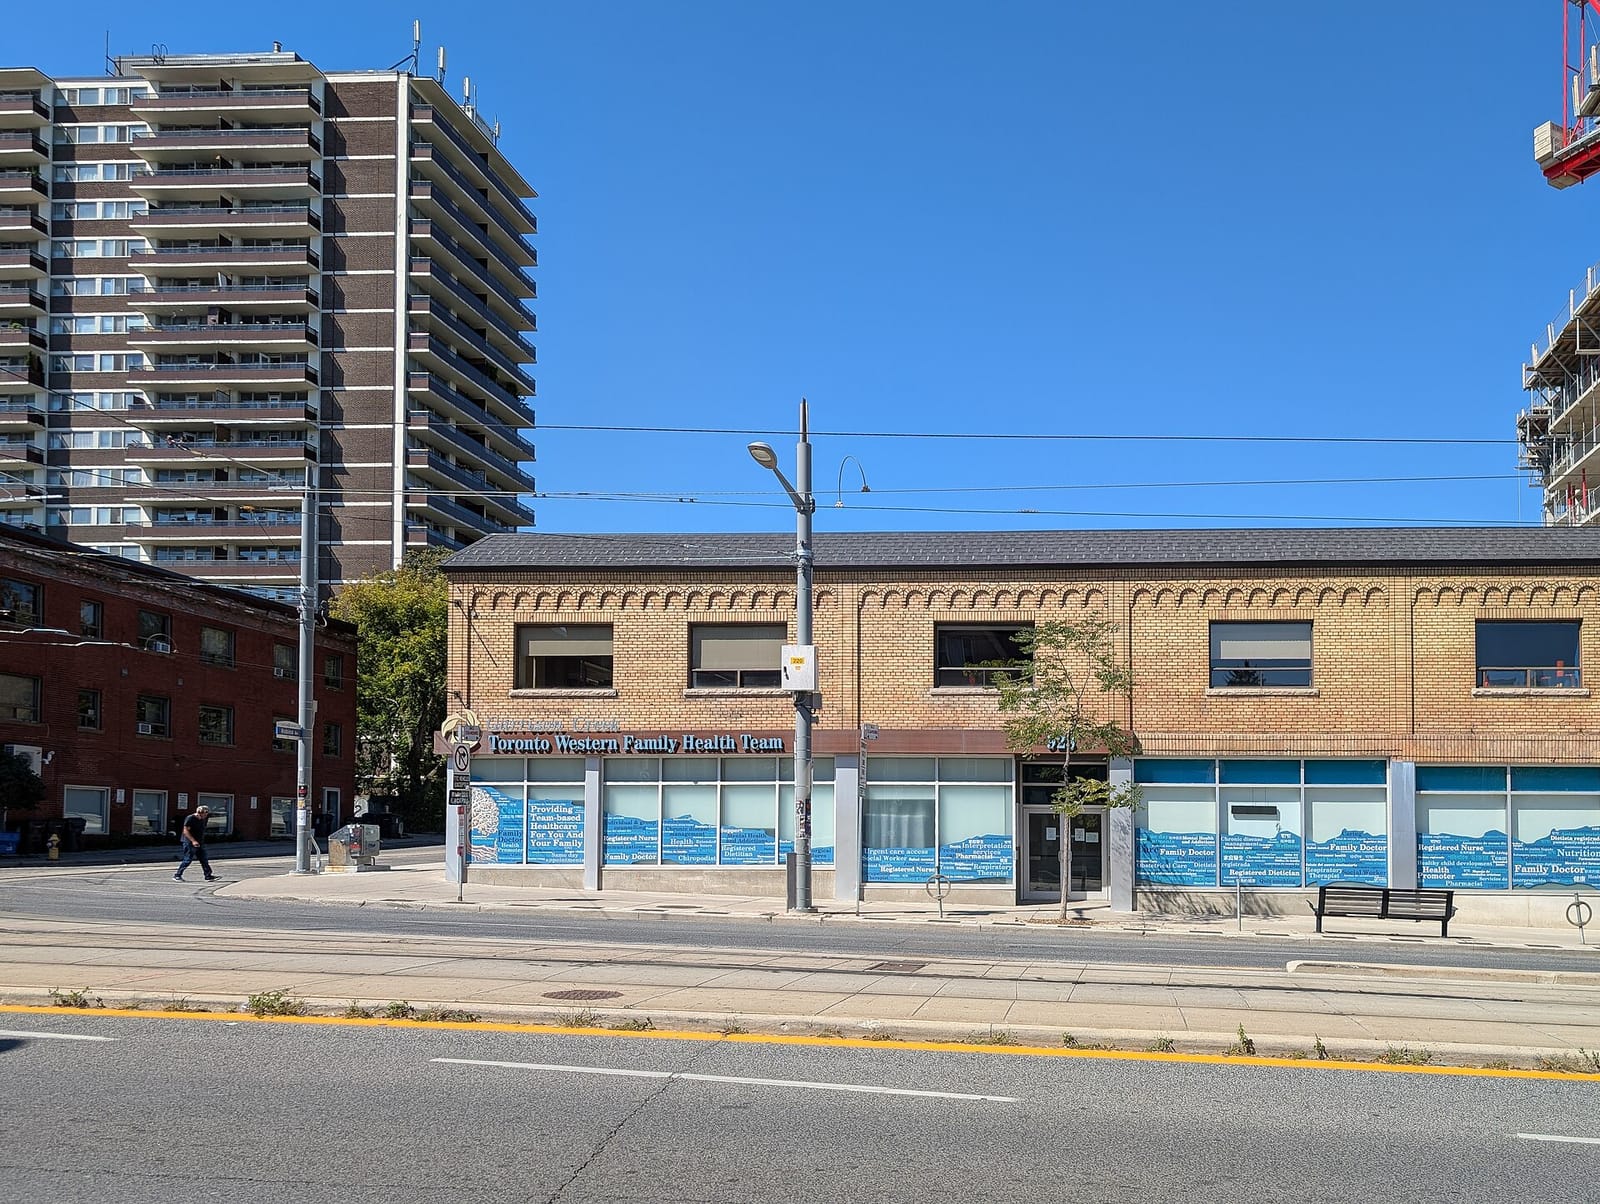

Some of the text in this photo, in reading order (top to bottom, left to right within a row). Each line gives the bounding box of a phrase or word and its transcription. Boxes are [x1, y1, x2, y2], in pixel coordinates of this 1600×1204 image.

[488, 735, 550, 751] Toronto
[555, 735, 617, 751] Western
[623, 735, 677, 753] Family
[682, 735, 736, 750] Health
[740, 735, 783, 750] Team
[531, 806, 573, 814] Providing
[531, 814, 581, 822] Team-based
[531, 822, 578, 830] Healthcare
[531, 839, 583, 848] Your Family
[962, 842, 1012, 850] Interpretation
[1330, 844, 1357, 852] Family
[1557, 849, 1600, 857] Nutrition
[605, 854, 629, 862] Family
[1515, 865, 1585, 874] Family Doctor
